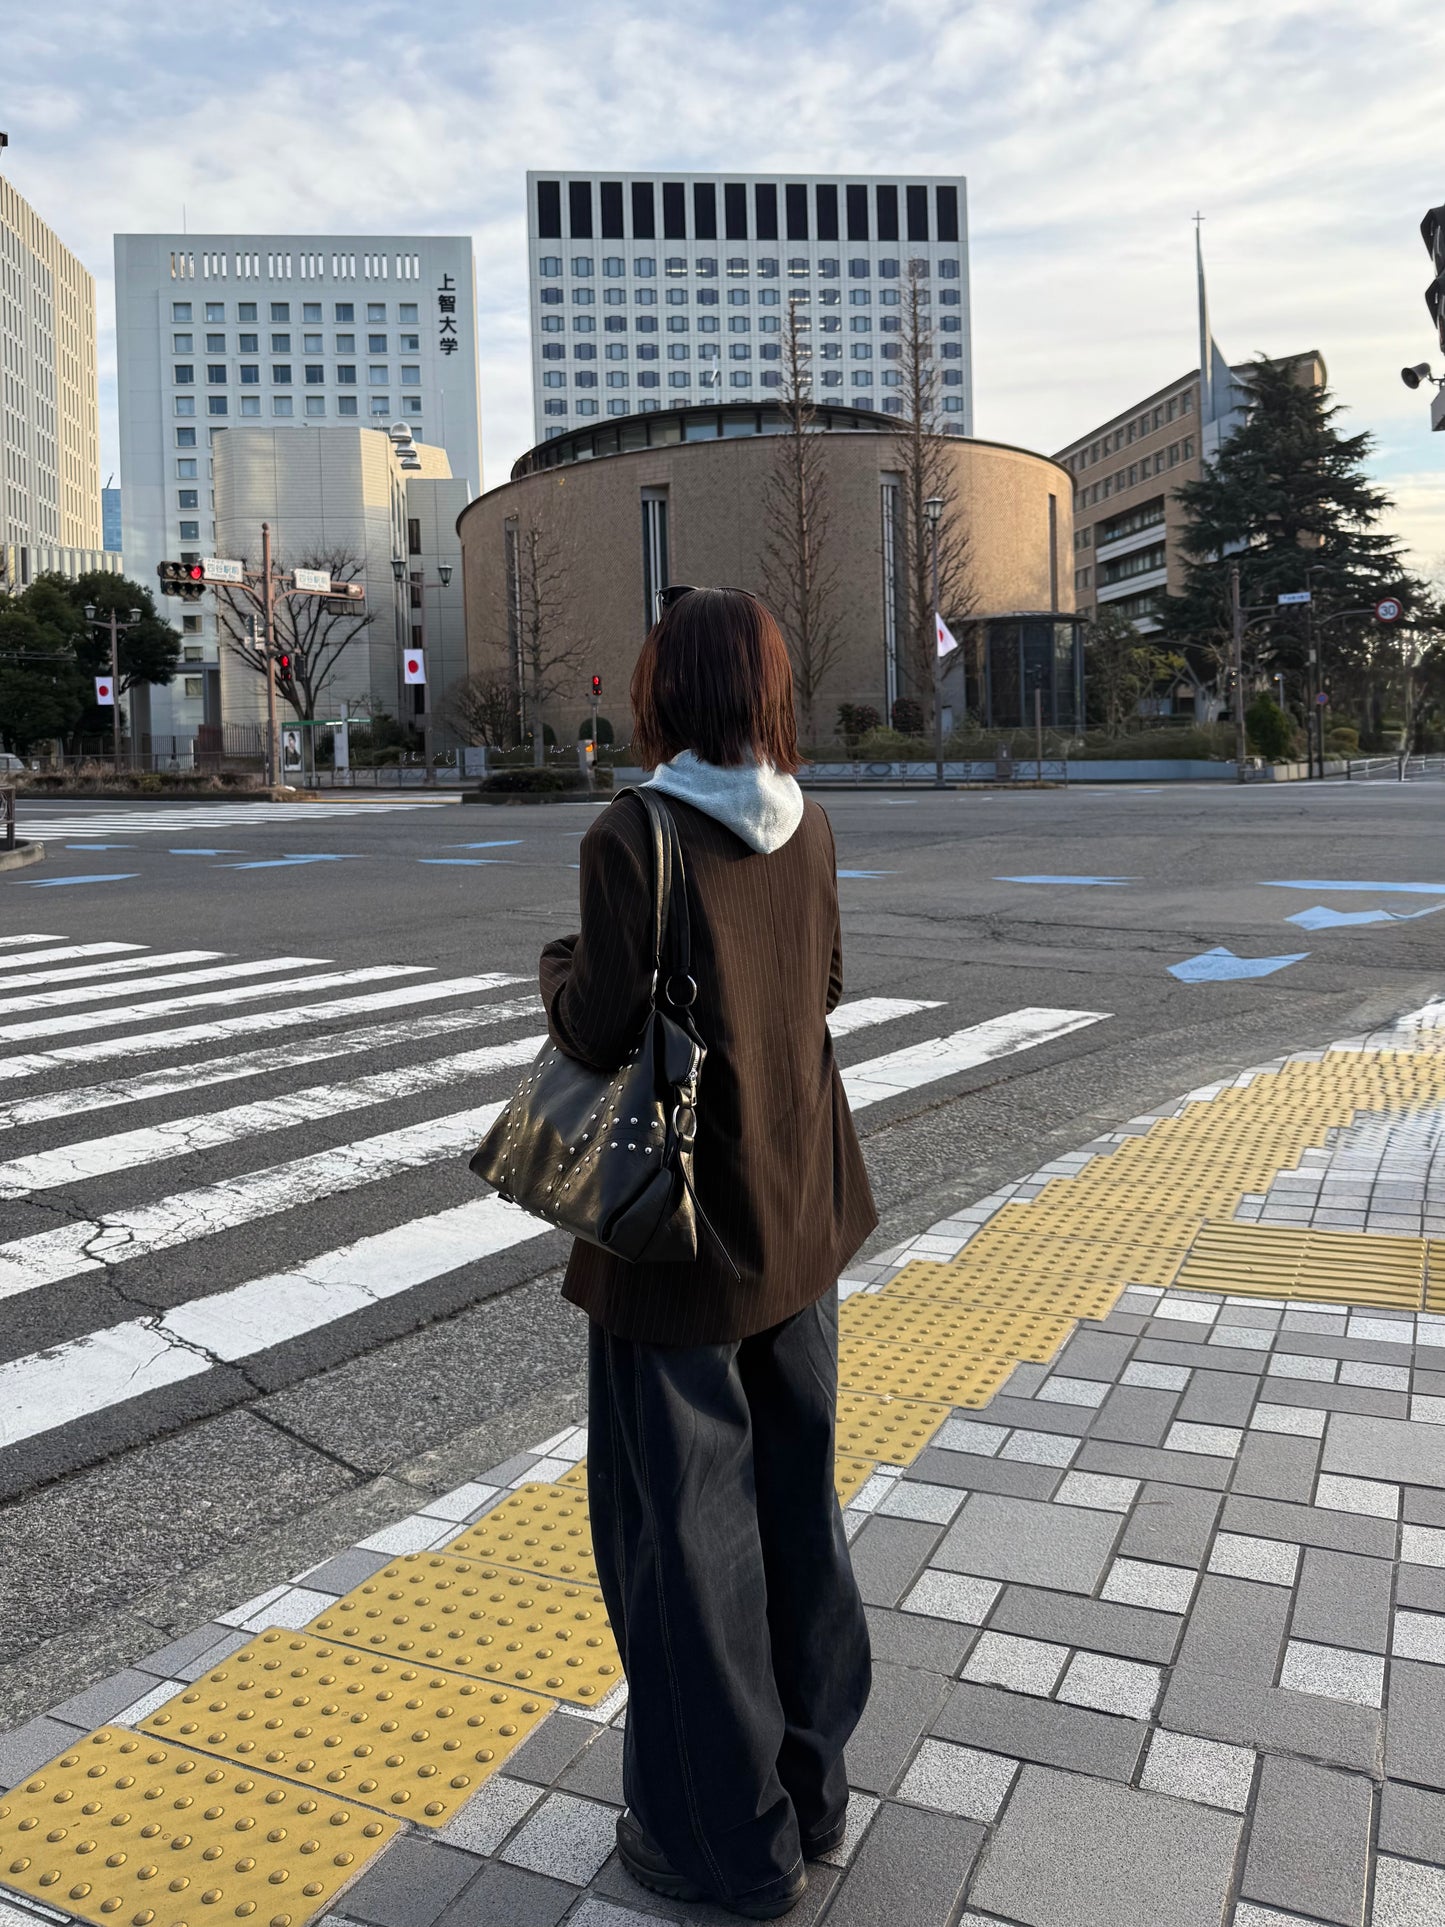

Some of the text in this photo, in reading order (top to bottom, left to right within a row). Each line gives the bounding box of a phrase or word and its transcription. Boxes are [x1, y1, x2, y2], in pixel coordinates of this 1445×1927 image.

[437, 273, 458, 355] 上智大学
[1380, 604, 1396, 617] 30
